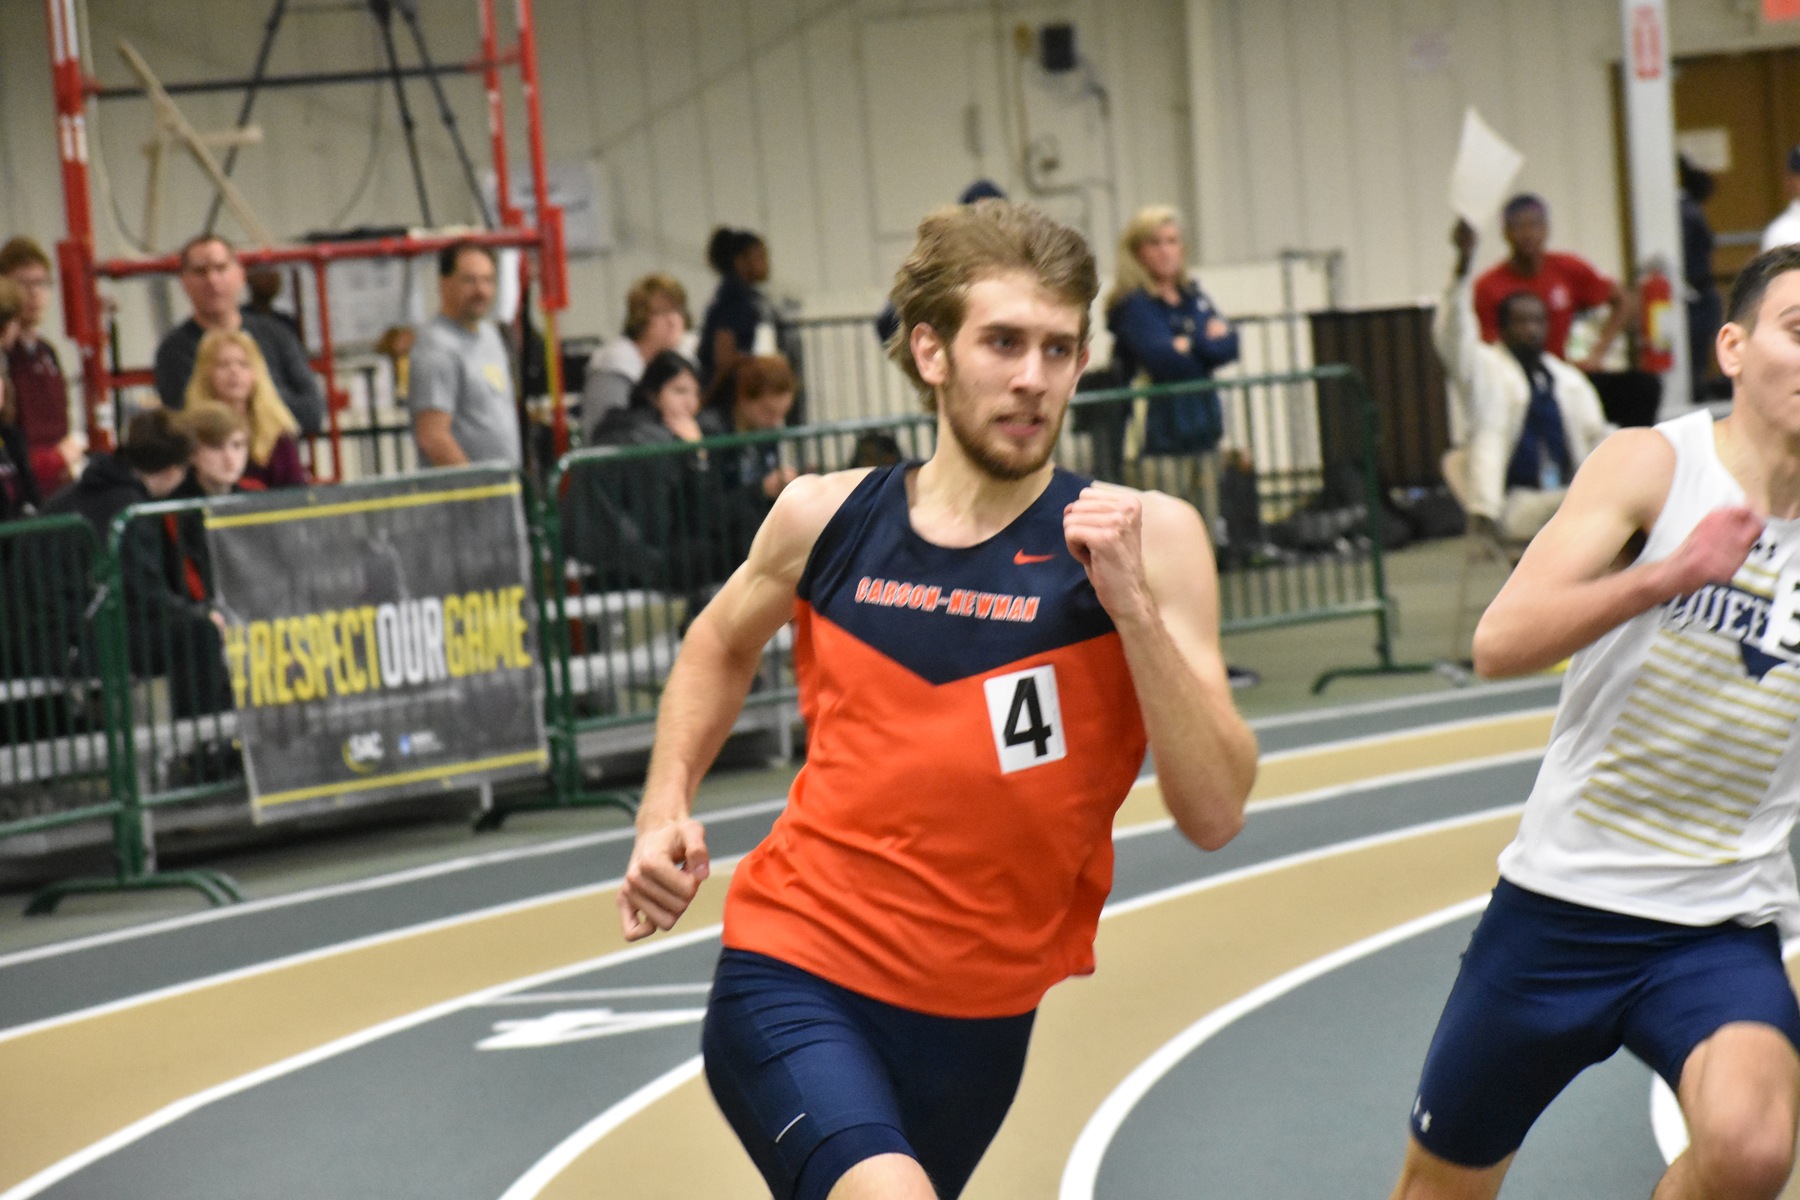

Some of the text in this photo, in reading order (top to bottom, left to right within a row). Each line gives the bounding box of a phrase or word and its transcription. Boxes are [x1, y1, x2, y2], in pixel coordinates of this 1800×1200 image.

[855, 576, 1041, 622] CARSON-NEWMAN
[225, 587, 531, 708] #RESPECTOURGAME
[1003, 674, 1053, 759] 4
